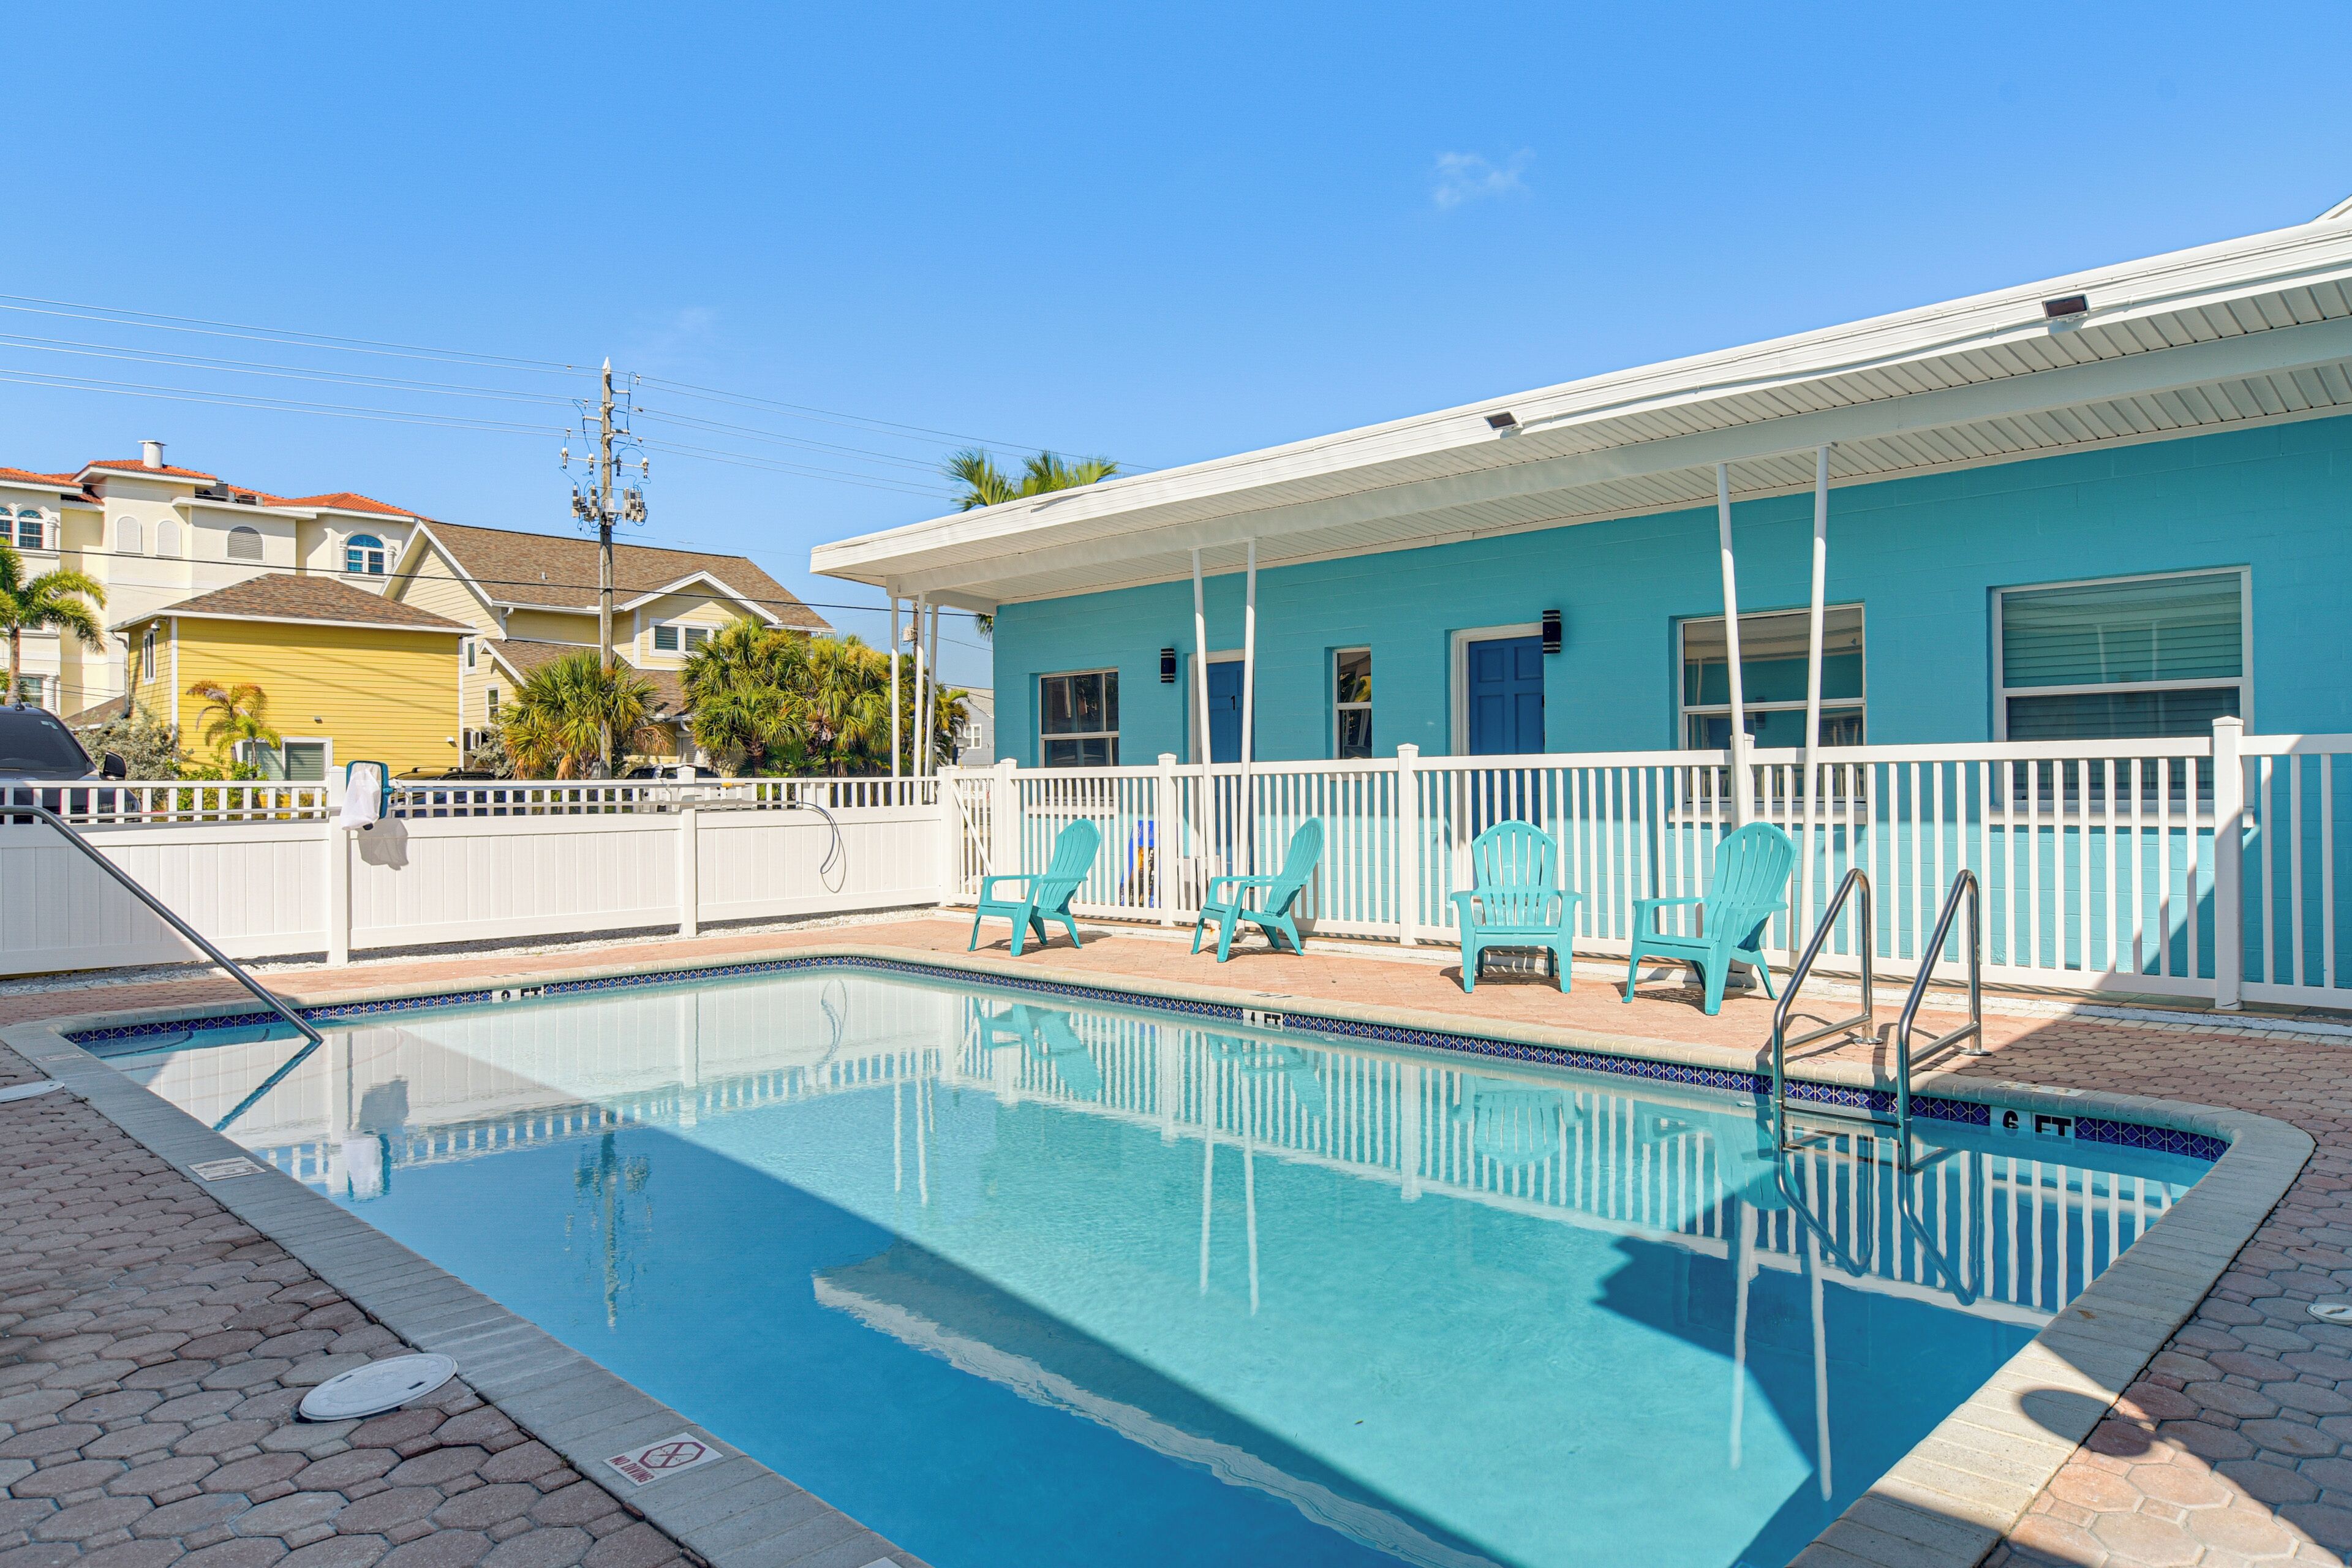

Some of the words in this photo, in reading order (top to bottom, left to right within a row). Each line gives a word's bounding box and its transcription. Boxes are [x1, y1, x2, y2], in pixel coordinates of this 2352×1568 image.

[1231, 695, 1235, 710] 1
[2035, 1114, 2071, 1137] FT
[609, 1455, 630, 1465] NO
[620, 1463, 655, 1482] DIVING
